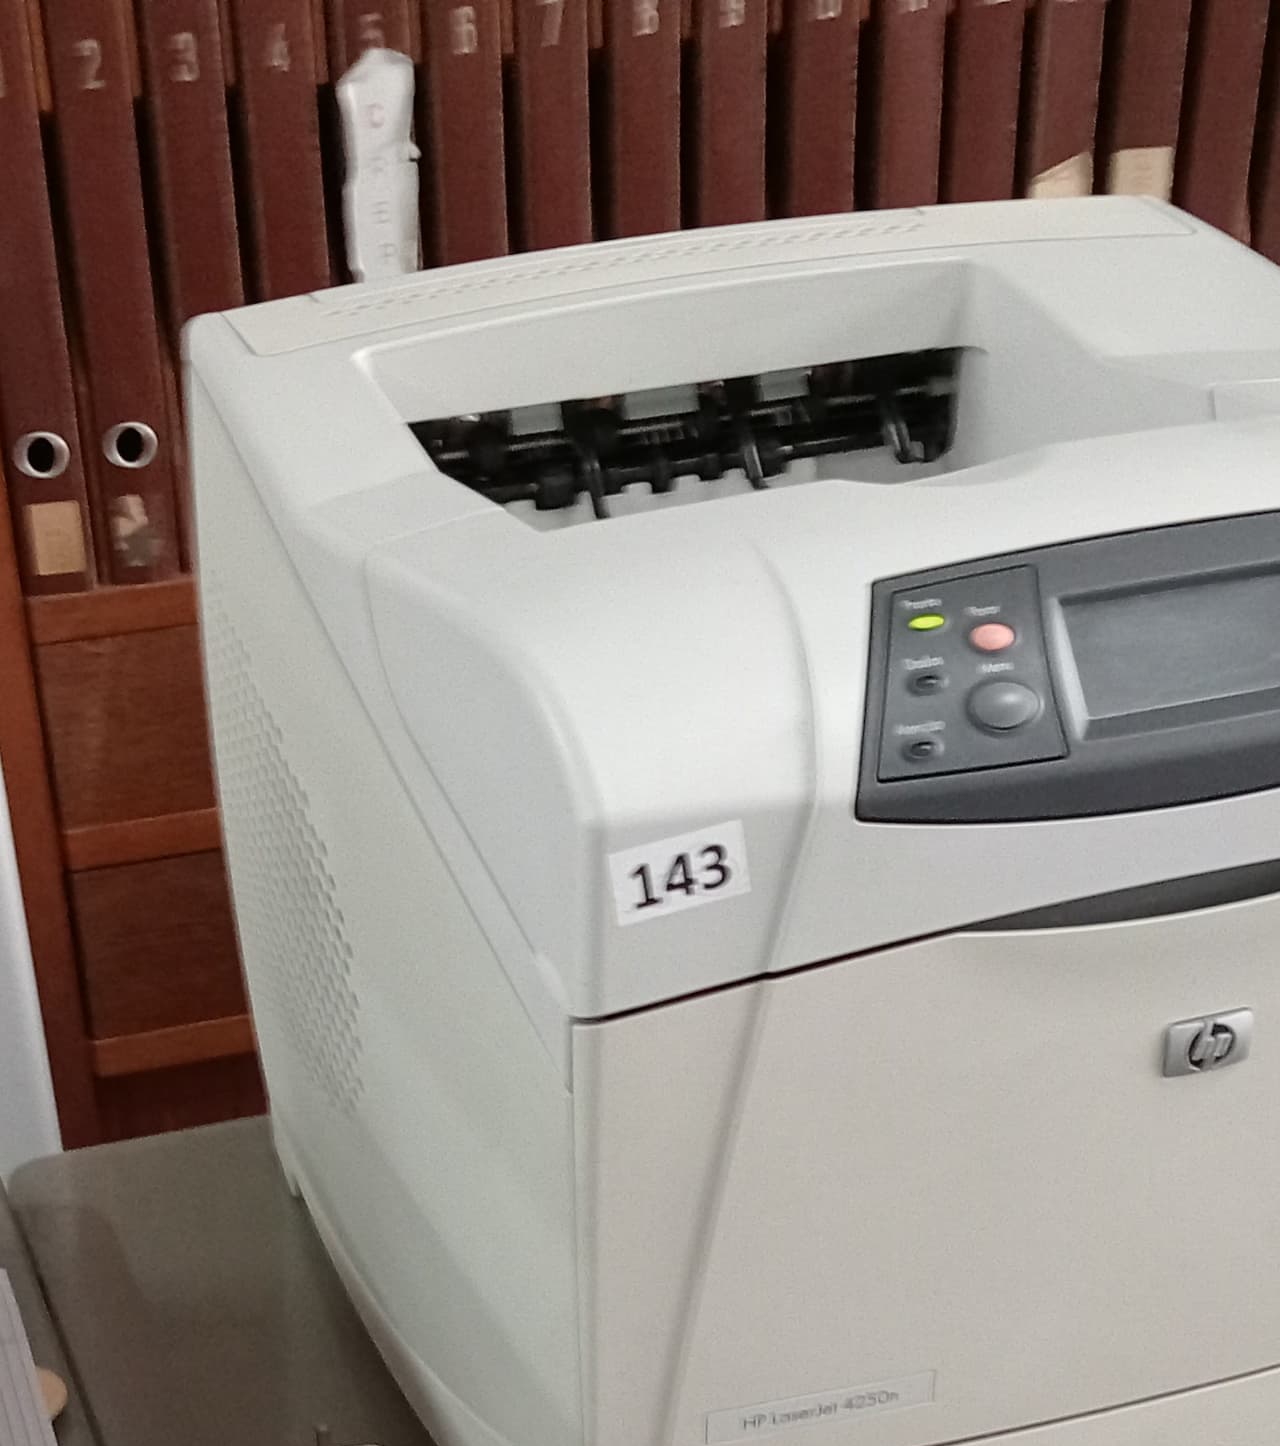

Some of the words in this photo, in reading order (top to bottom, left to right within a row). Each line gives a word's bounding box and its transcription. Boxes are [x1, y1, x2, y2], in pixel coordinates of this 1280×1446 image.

[629, 844, 732, 909] 143
[743, 1413, 767, 1431] HP
[773, 1403, 839, 1425] LaserJet
[844, 1390, 899, 1410] 4250n
